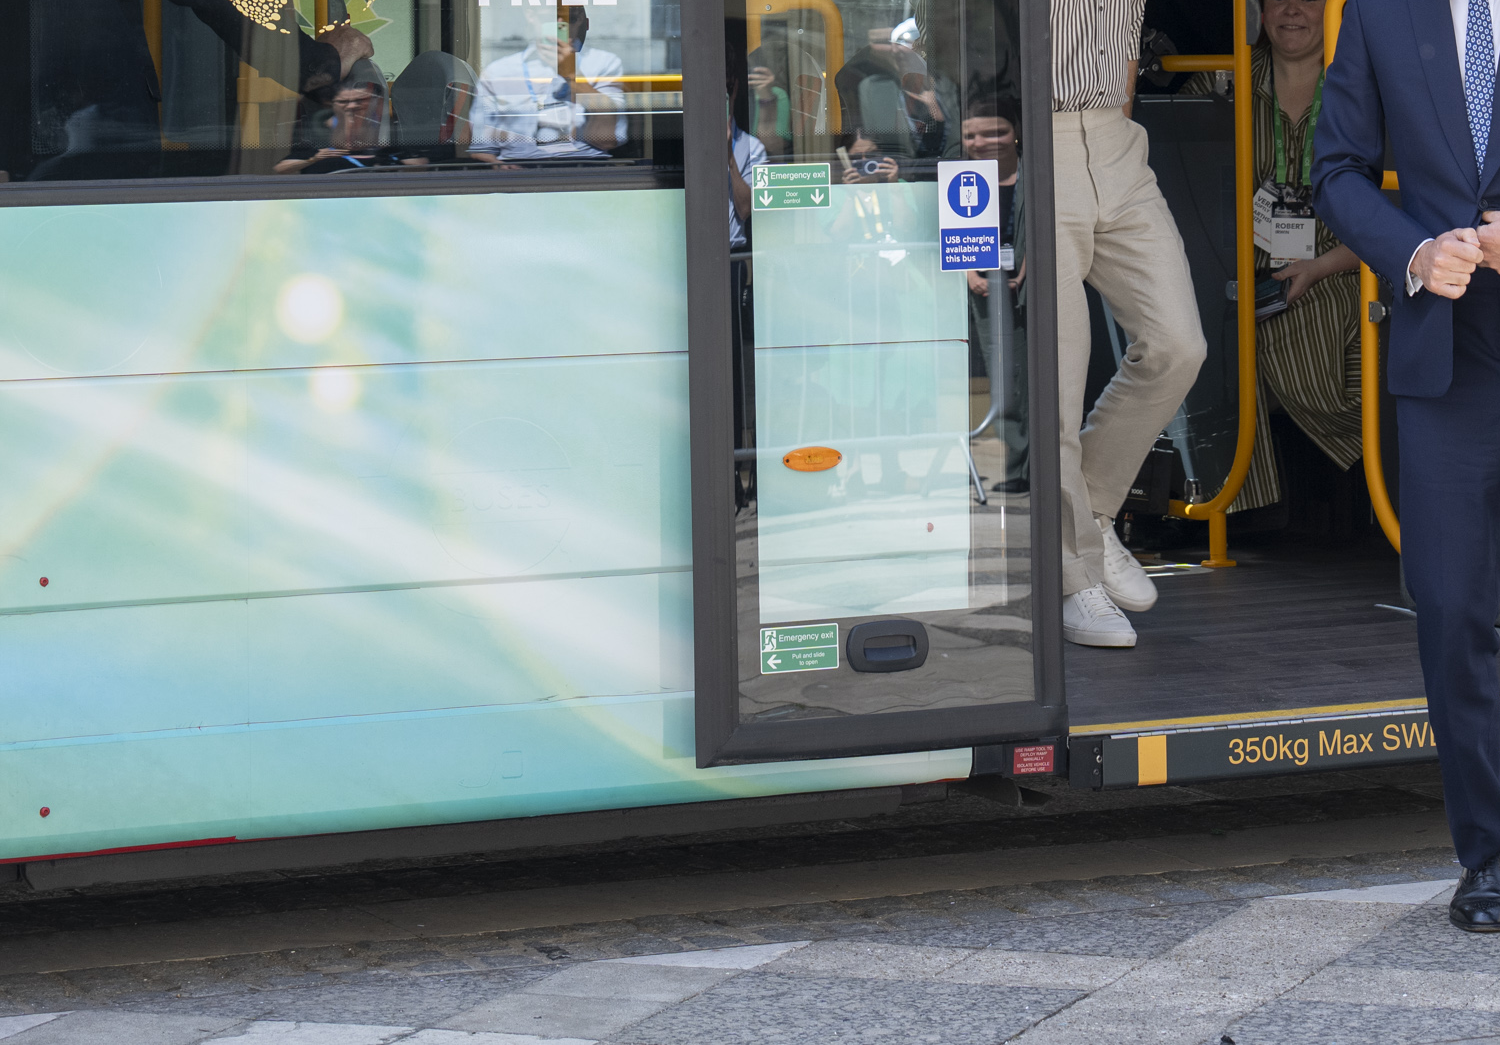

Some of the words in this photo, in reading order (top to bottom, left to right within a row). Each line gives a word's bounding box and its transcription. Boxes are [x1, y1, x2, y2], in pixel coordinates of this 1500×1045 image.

[770, 172, 811, 181] Emergency
[812, 170, 826, 179] exit
[1275, 222, 1305, 230] ROBERT
[945, 235, 961, 244] USB
[962, 234, 995, 244] charging
[945, 244, 980, 254] available
[945, 254, 961, 263] this
[962, 254, 977, 263] bus
[778, 633, 819, 642] Emergency
[820, 631, 834, 639] exit
[1228, 734, 1309, 766] 350kg
[1319, 729, 1374, 757] Max
